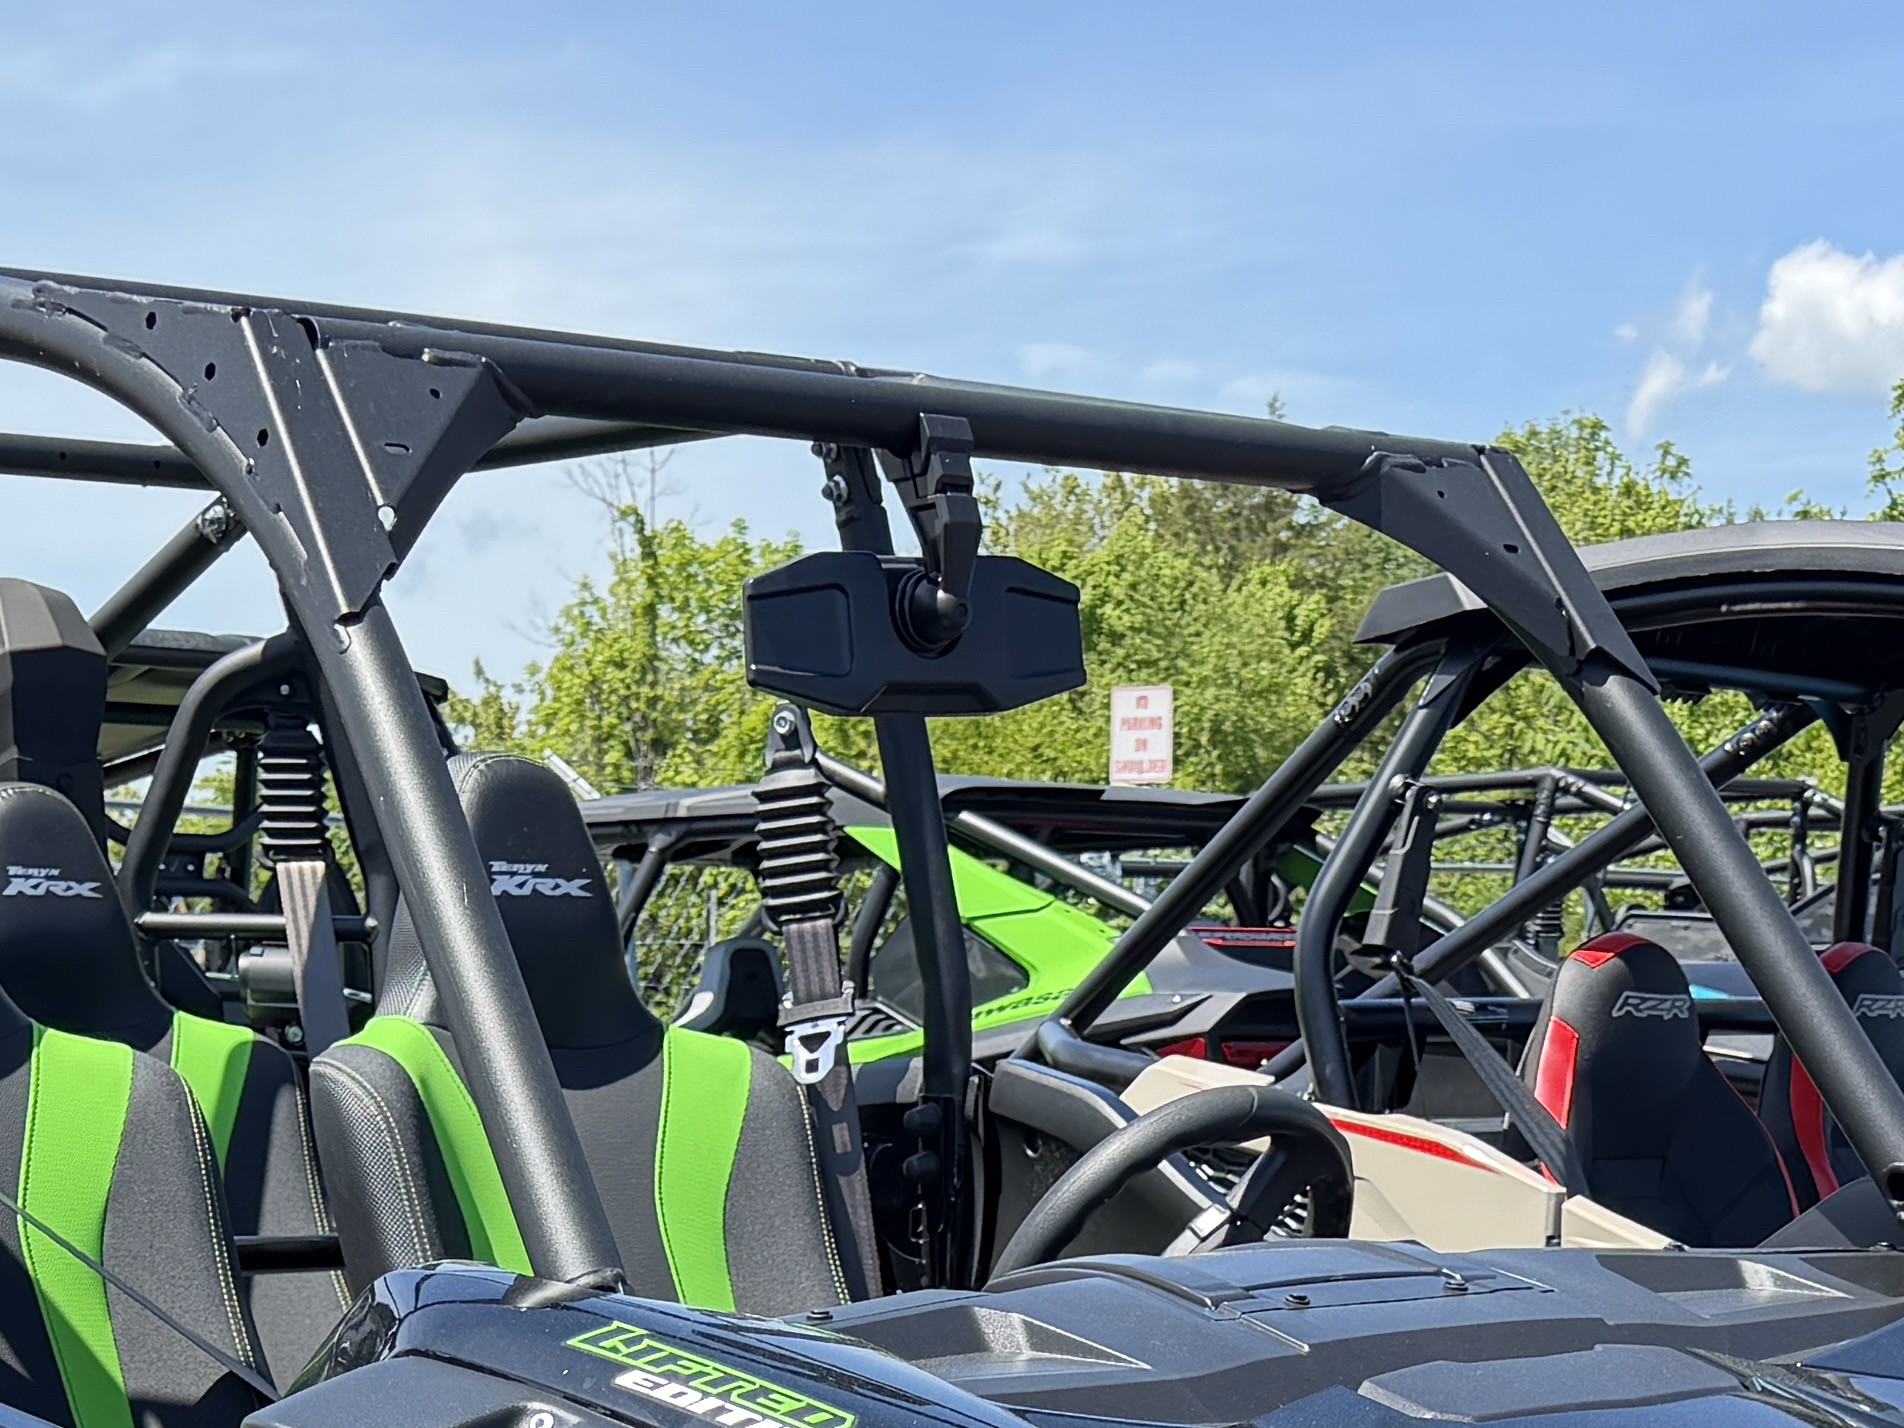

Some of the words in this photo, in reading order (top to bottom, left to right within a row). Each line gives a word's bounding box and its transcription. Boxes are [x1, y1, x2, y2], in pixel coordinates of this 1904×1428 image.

[1, 877, 104, 899] KRX
[489, 874, 594, 897] KRX
[1611, 990, 1692, 1020] RZR
